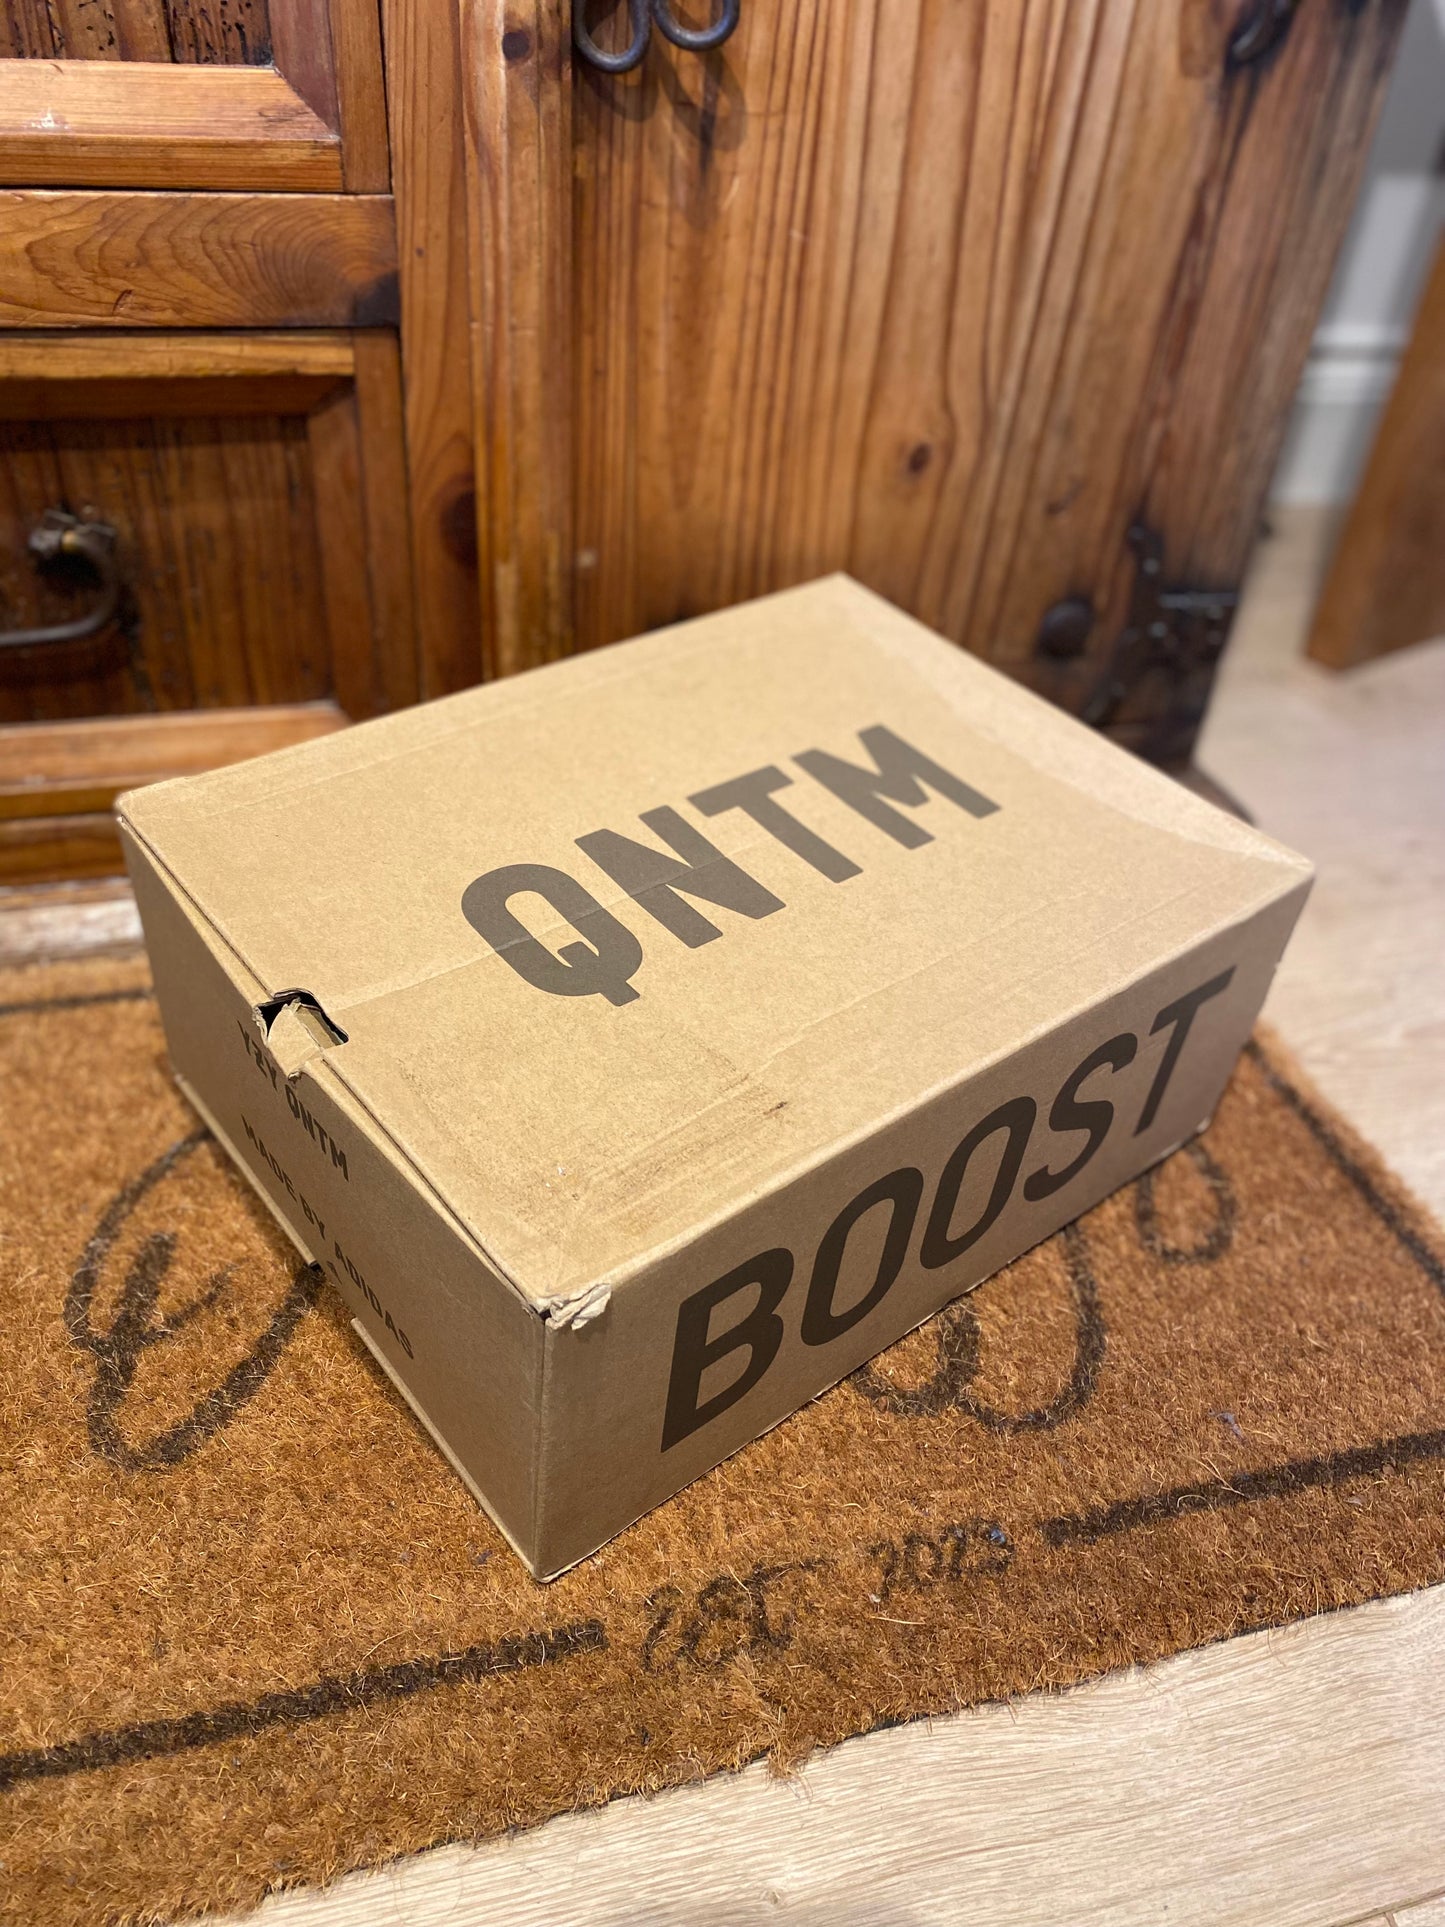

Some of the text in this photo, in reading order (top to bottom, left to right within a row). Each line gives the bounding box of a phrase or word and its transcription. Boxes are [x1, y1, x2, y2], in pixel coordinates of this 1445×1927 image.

[461, 723, 1002, 1007] QNTM
[240, 1113, 414, 1360] MADE BY ADIDAS
[285, 1083, 350, 1182] QNTM
[660, 965, 1237, 1452] BOOST
